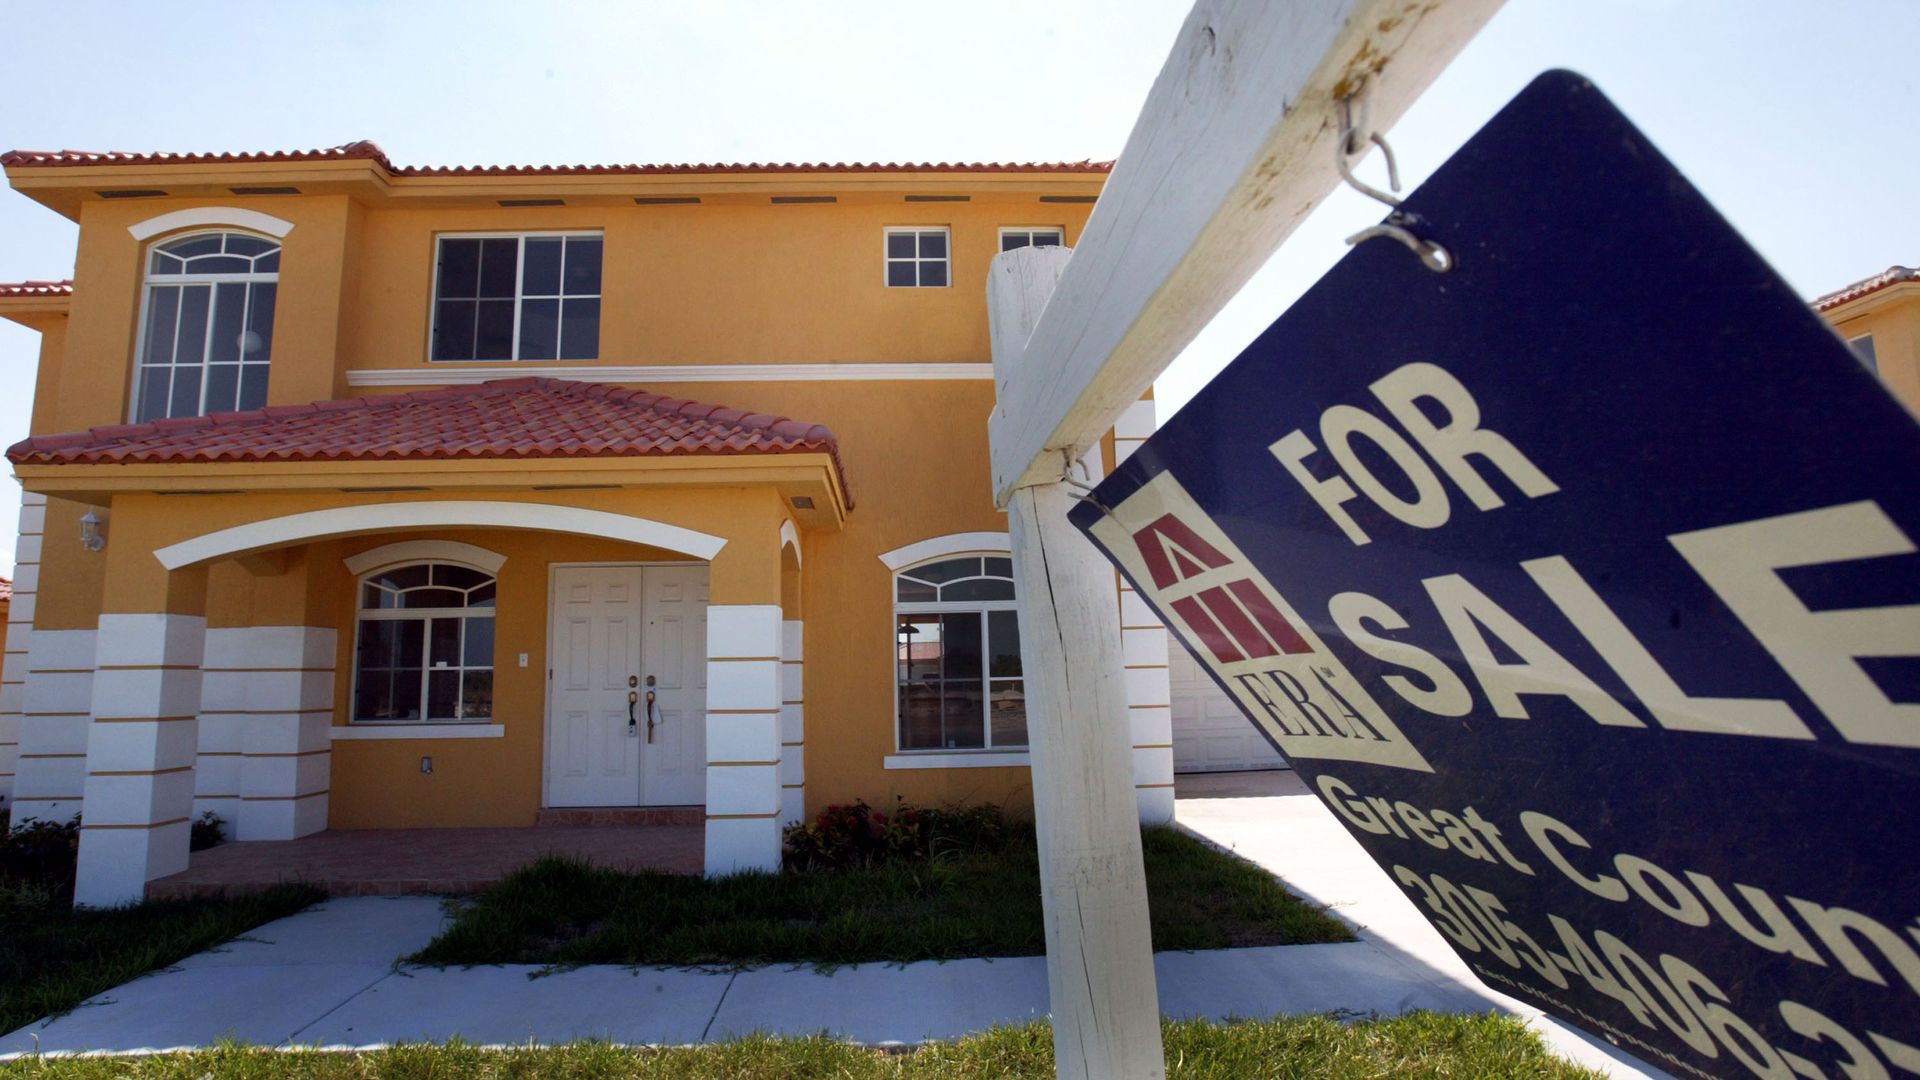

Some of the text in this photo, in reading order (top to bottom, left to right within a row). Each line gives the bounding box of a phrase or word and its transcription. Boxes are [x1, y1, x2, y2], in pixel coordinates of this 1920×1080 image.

[1267, 361, 1561, 546] FOR
[1233, 665, 1392, 742] ERA
[1328, 500, 1920, 749] SALE
[1316, 774, 1920, 999] Great Coun
